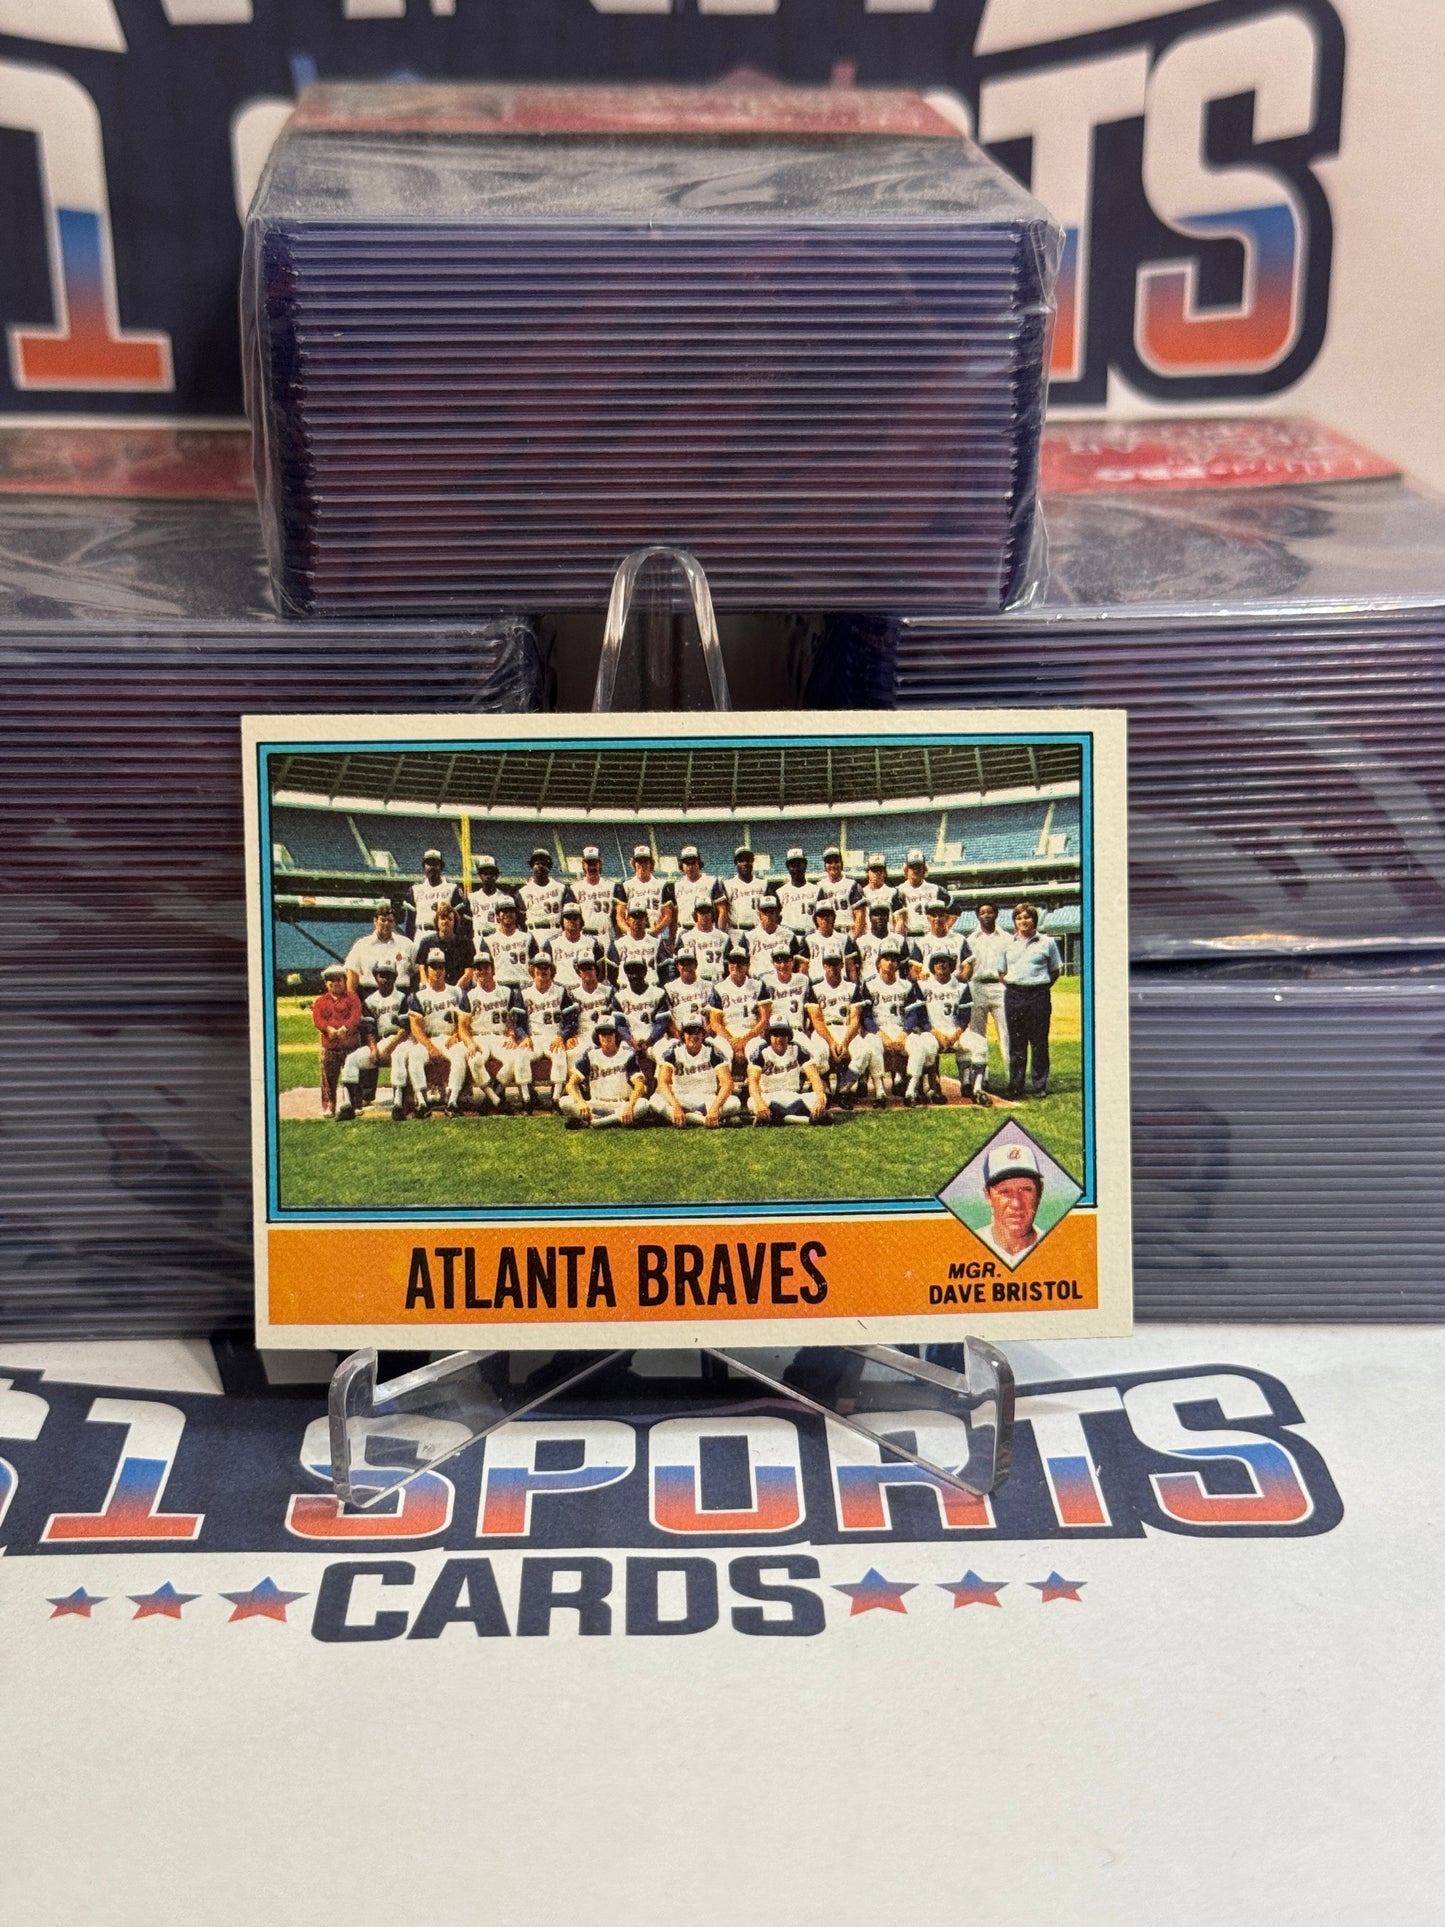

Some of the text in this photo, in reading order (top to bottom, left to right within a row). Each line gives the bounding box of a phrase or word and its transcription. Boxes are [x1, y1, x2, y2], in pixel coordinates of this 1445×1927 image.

[405, 1241, 828, 1309] ATLANTA BRAVES
[929, 1279, 1083, 1305] DAVE BRISTOL
[948, 1261, 1002, 1279] MGR.
[283, 1373, 1315, 1540] SPORTS
[310, 1554, 827, 1643] CARDS
